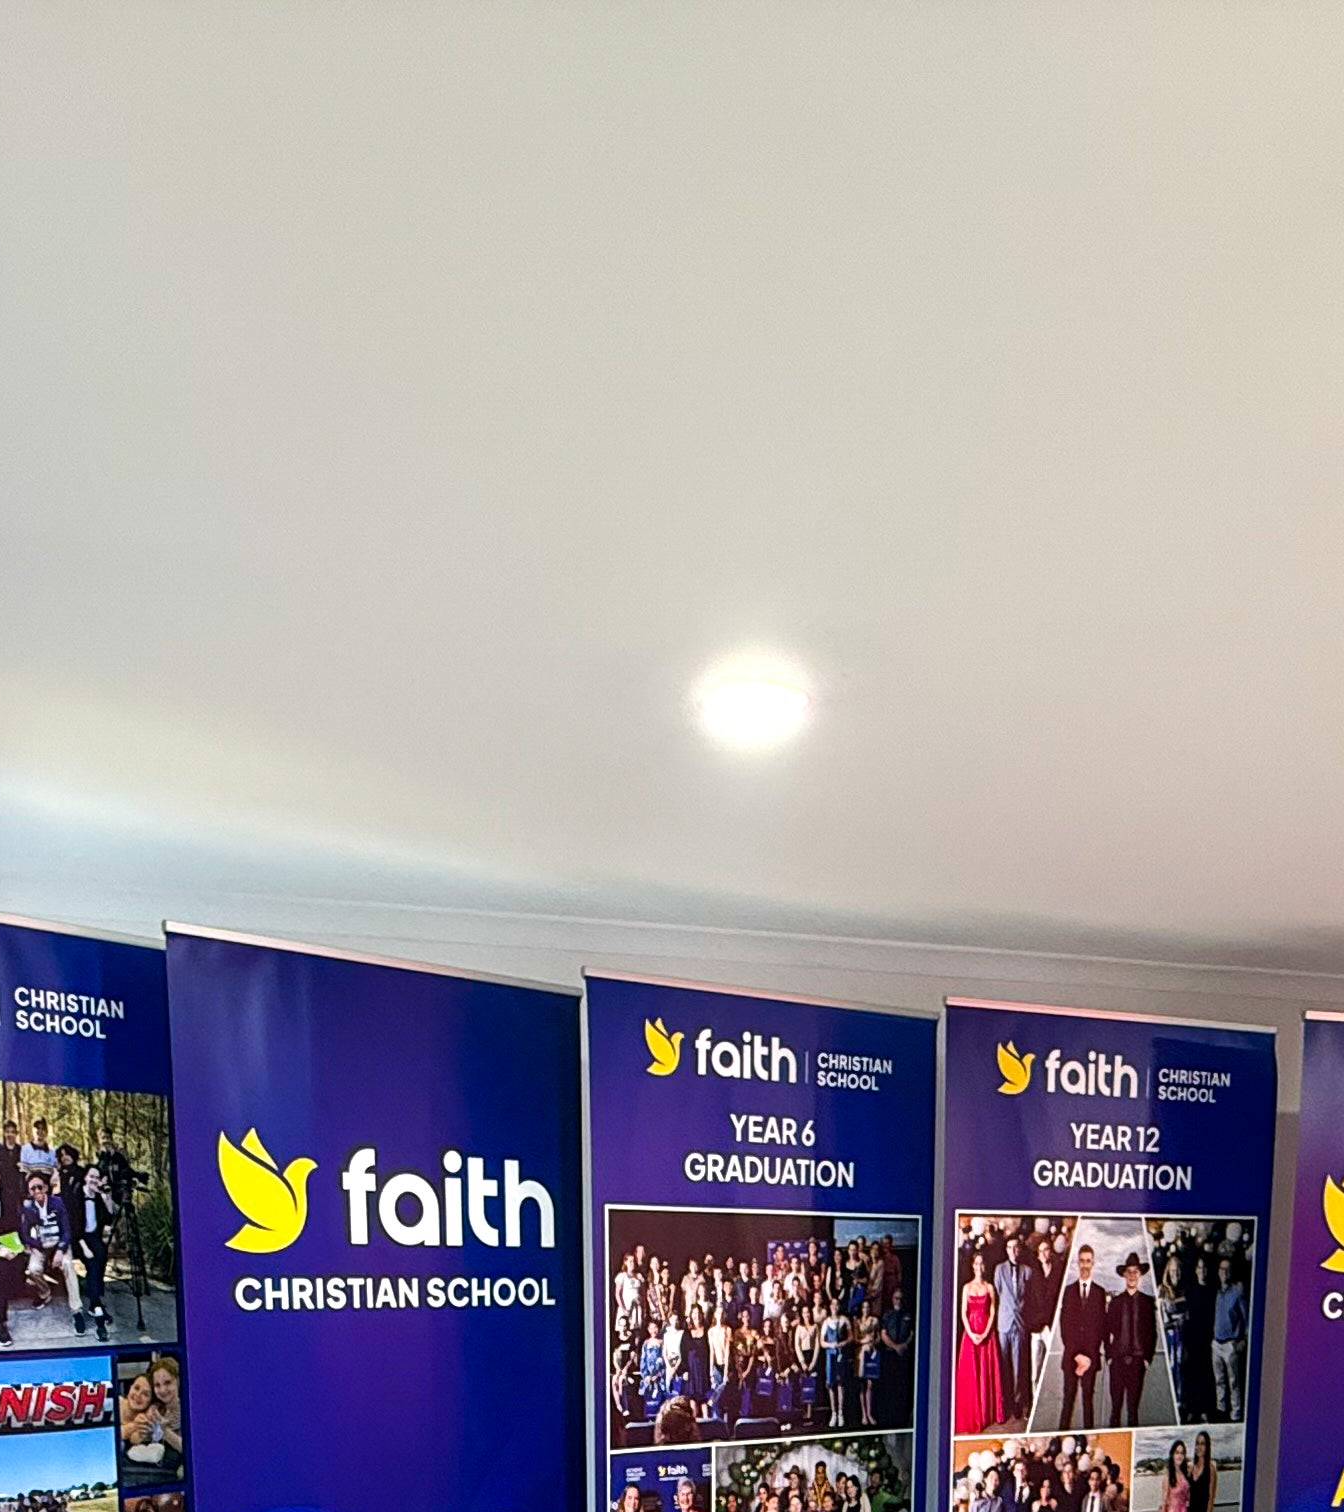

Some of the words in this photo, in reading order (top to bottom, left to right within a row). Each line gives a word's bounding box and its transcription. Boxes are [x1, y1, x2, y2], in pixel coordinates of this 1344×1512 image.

[14, 986, 124, 1020] CHRISTIAN
[16, 1009, 107, 1039] SCHOOL
[695, 1028, 797, 1083] faith
[817, 1052, 893, 1075] CHRISTIAN
[816, 1071, 879, 1091] SCHOOL
[1045, 1049, 1138, 1099] faith
[1158, 1068, 1231, 1088] CHRISTIAN
[1158, 1086, 1216, 1103] SCHOOL
[729, 1113, 797, 1146] YEAR
[801, 1119, 816, 1147] 6
[1070, 1122, 1138, 1152] YEAR
[1138, 1126, 1160, 1153] 12
[684, 1152, 854, 1188] GRADUATION
[1033, 1159, 1192, 1191] GRADUATION
[342, 1148, 555, 1248] faith
[235, 1277, 419, 1311] CHRISTIAN
[426, 1277, 556, 1308] SCHOOL
